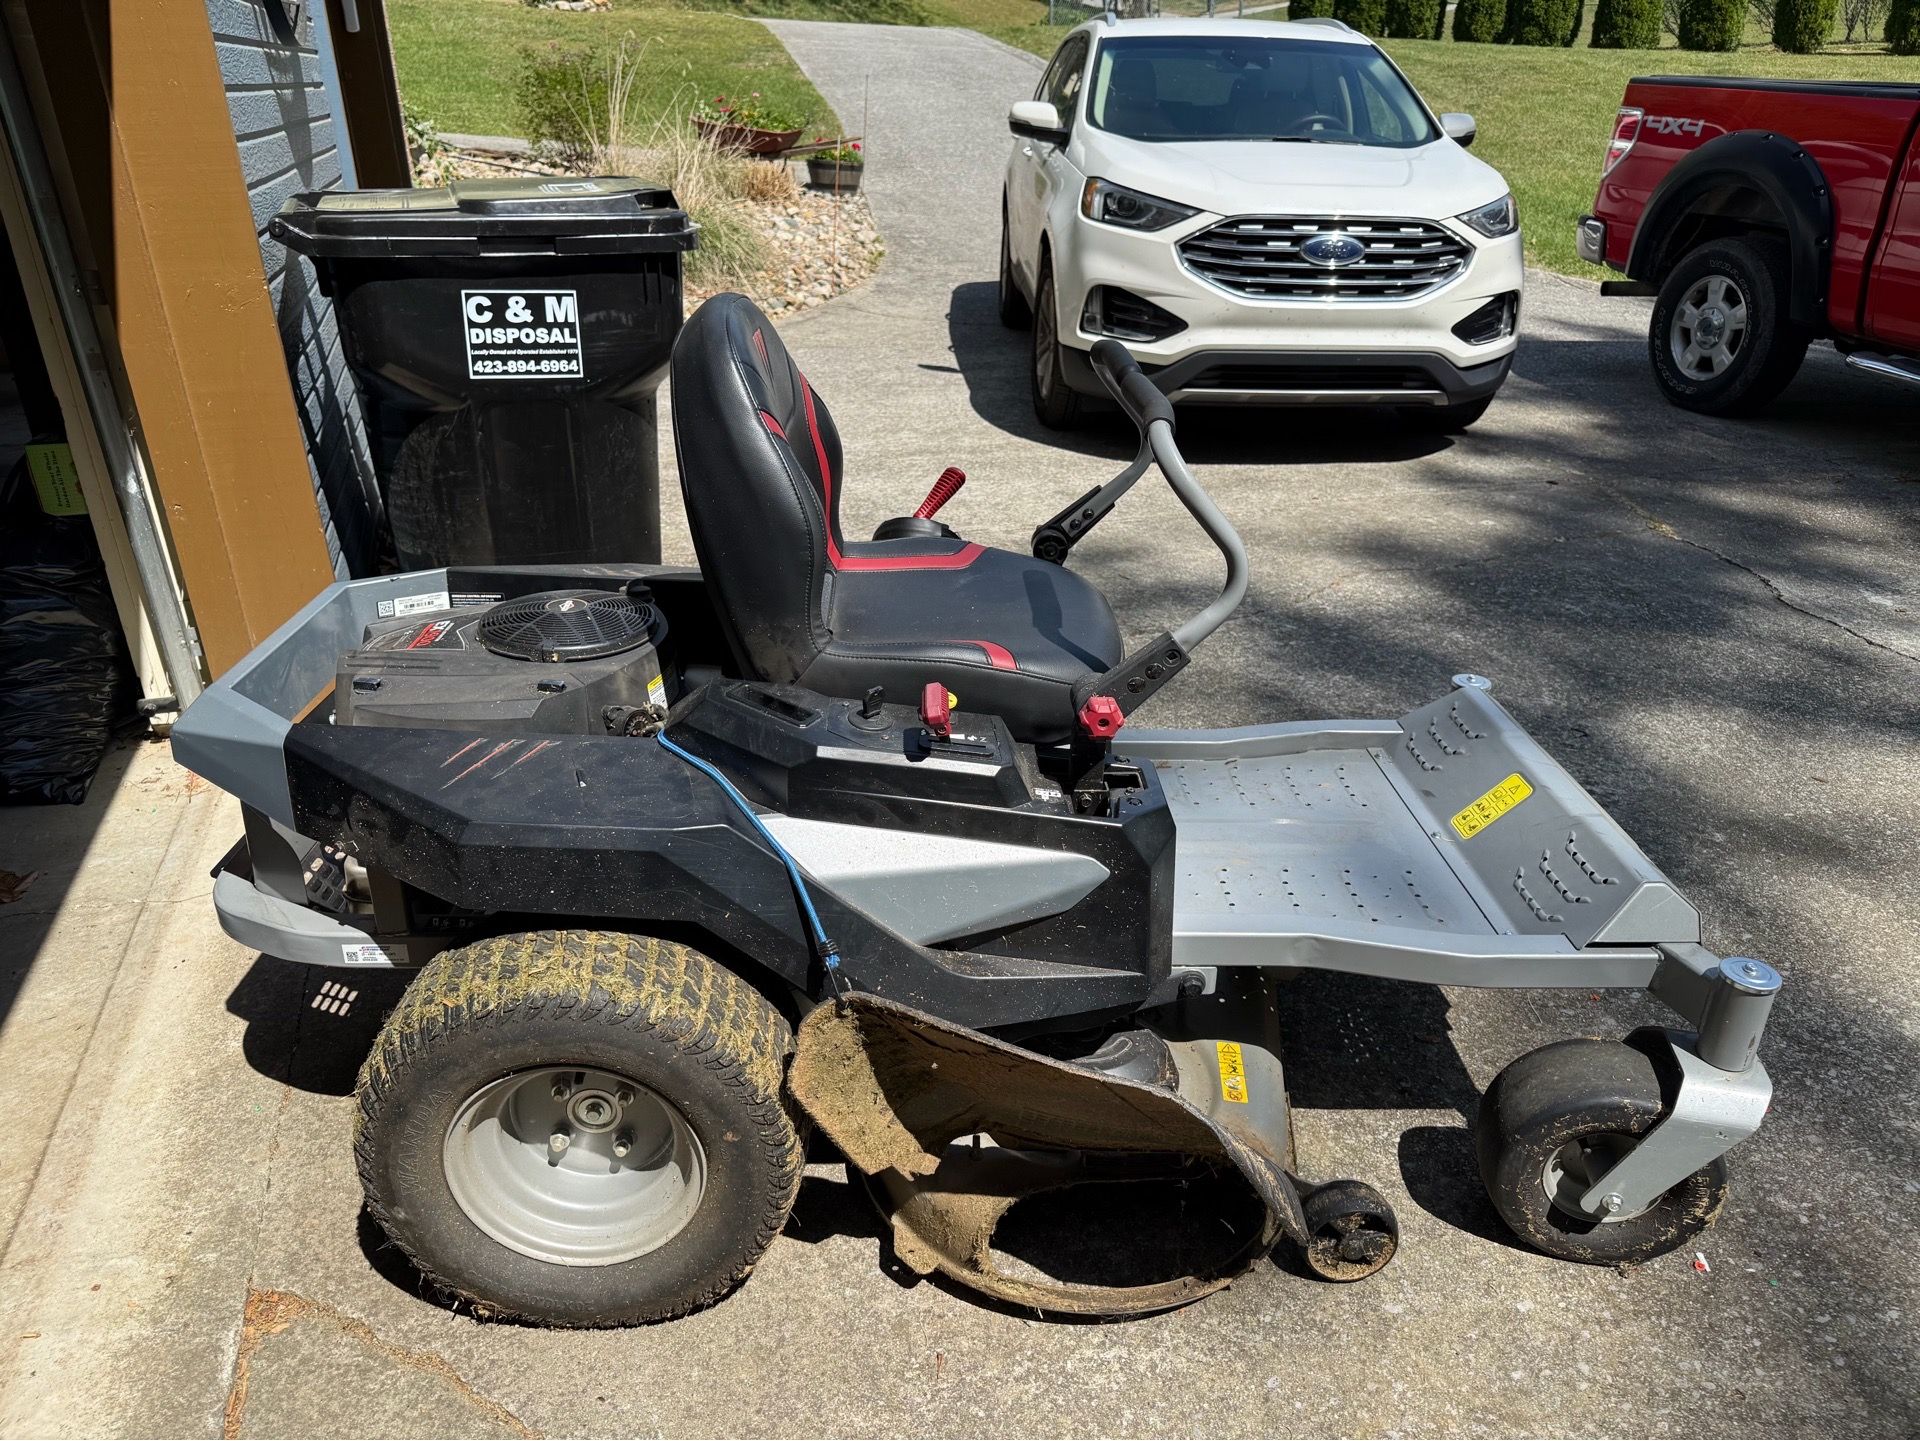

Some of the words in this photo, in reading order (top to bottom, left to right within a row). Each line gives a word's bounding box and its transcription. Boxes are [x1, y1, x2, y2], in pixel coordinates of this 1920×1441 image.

[467, 295, 493, 323] C
[505, 296, 534, 323] &
[545, 296, 576, 323] M
[470, 327, 577, 344] DISPOSAL
[1655, 307, 1697, 395] GOODYEAR
[473, 360, 579, 373] 423-894-6964
